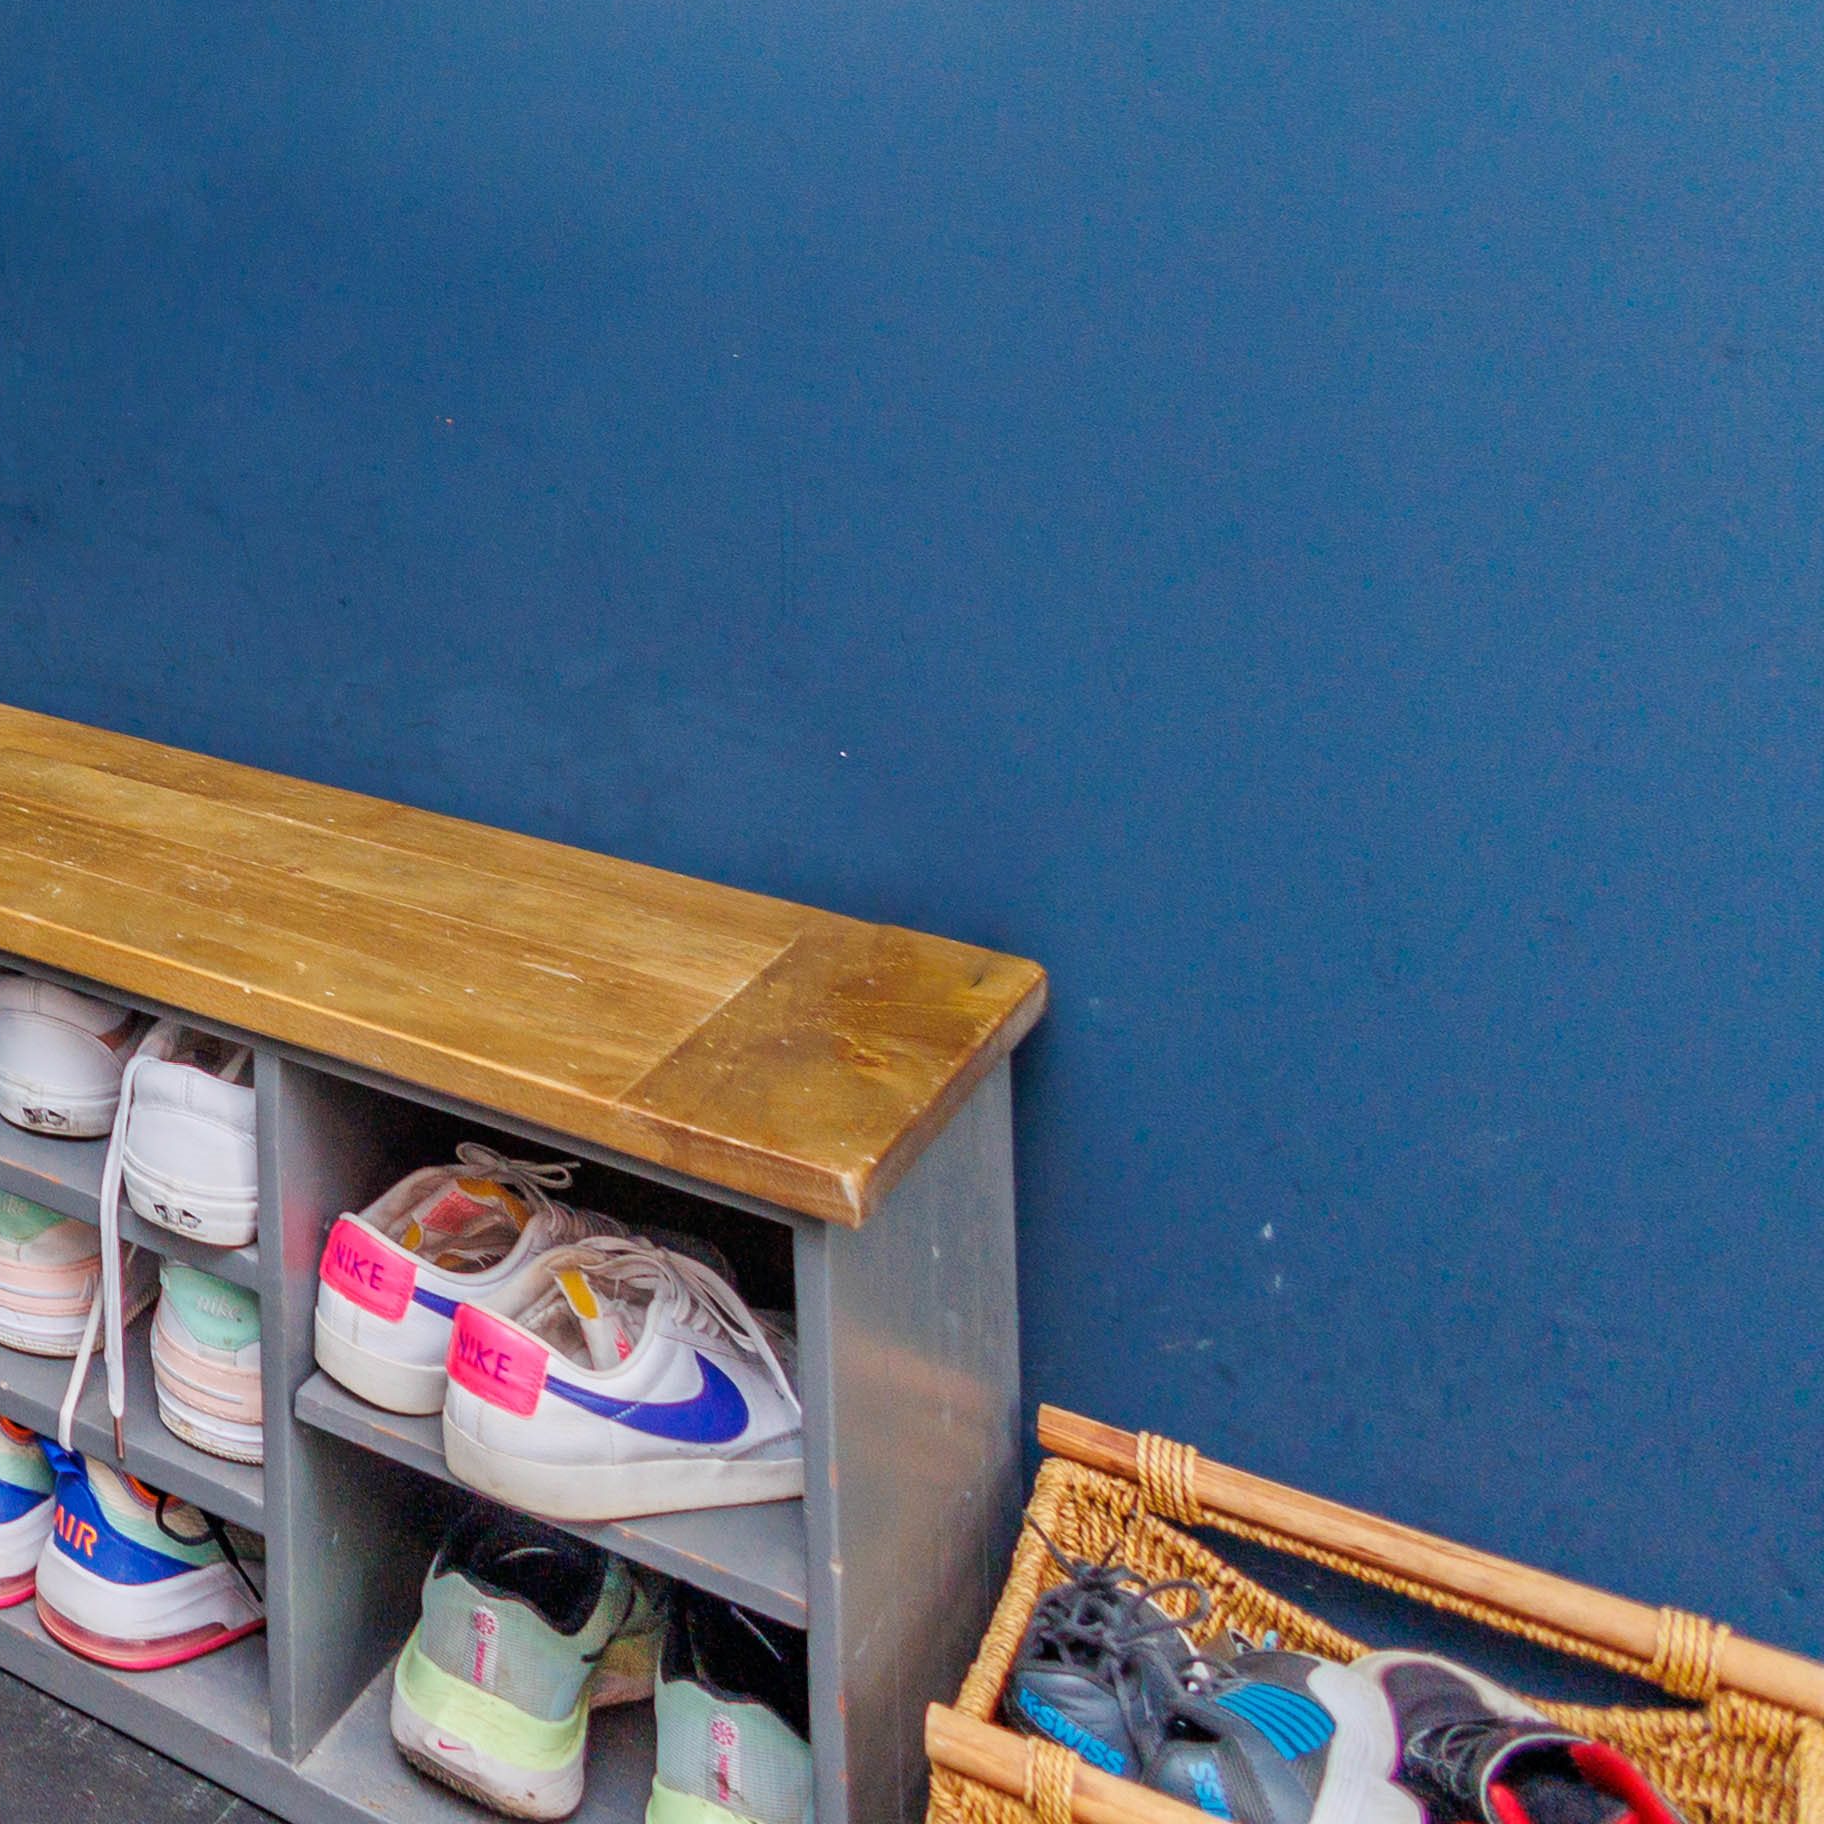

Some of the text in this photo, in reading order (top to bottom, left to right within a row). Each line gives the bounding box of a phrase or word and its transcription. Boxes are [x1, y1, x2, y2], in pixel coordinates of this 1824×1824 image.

[335, 1240, 385, 1292] NIKE
[458, 1330, 513, 1385] NIKE
[54, 1503, 99, 1559] AIR
[1018, 1686, 1128, 1776] K-SWISS
